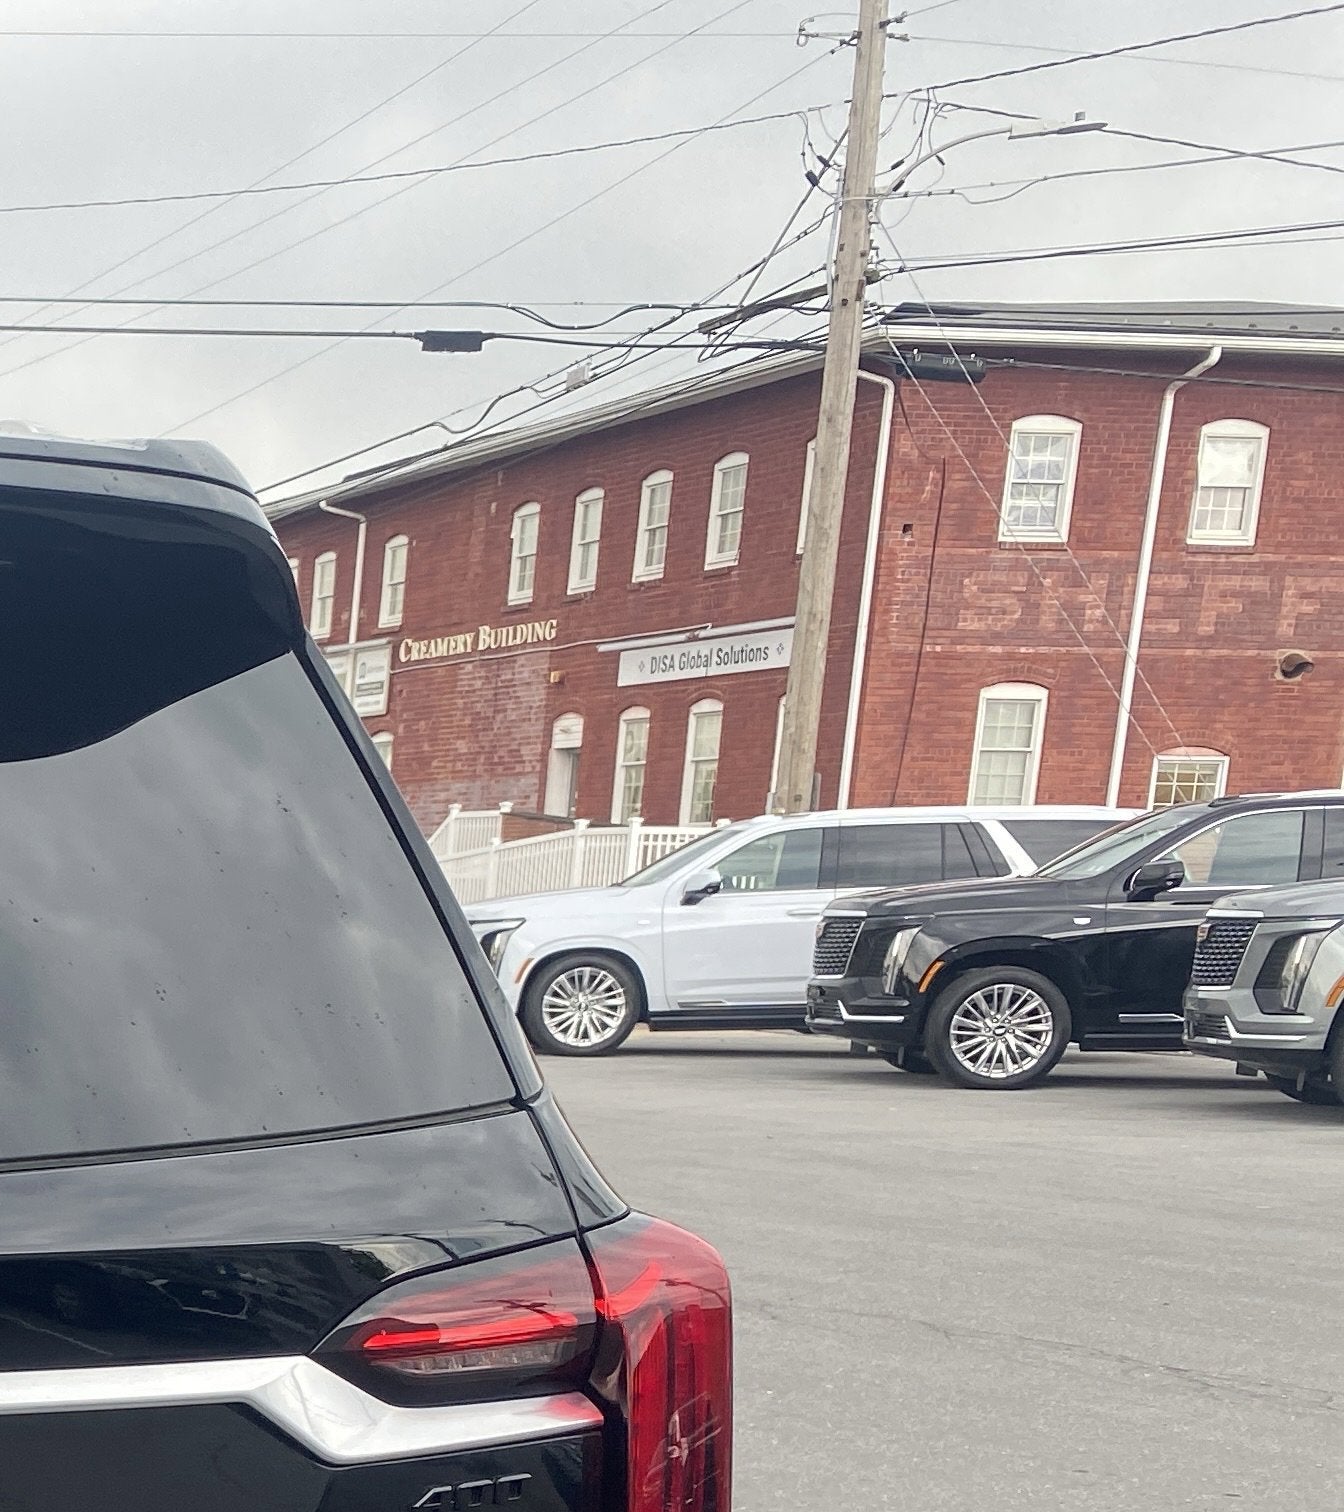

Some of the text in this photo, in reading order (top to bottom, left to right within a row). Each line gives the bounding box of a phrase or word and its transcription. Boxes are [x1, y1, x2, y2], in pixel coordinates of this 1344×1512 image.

[398, 618, 558, 663] CREAMERY BUILDING
[649, 643, 769, 675] DISA Global Solutions
